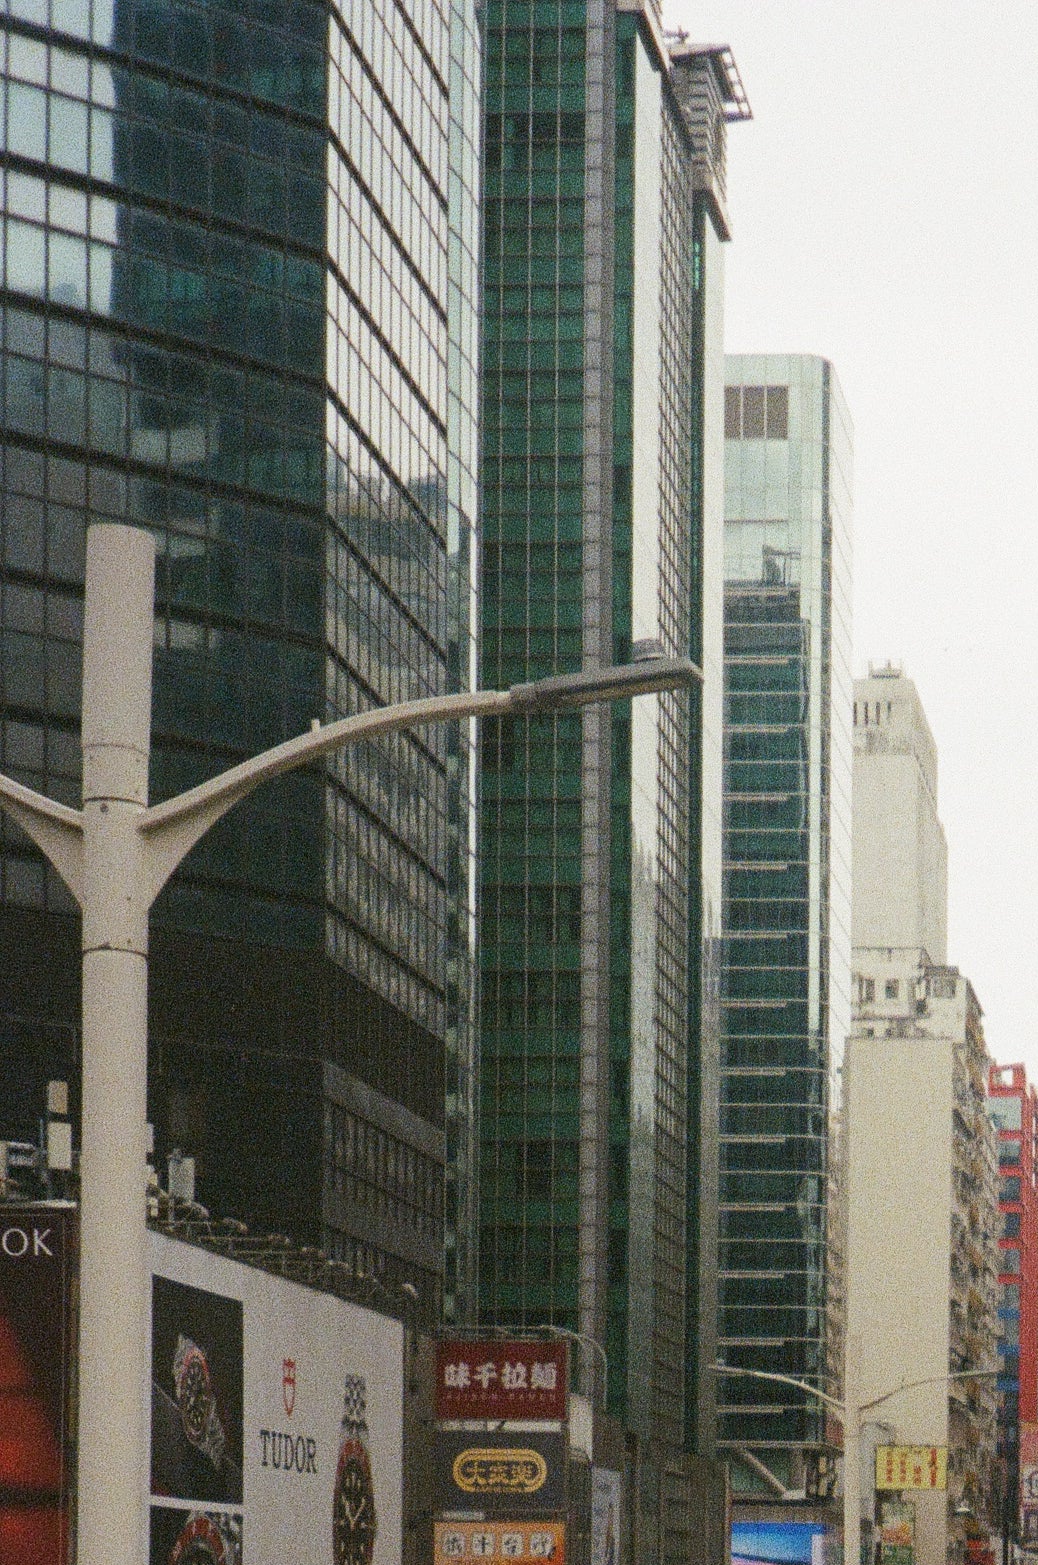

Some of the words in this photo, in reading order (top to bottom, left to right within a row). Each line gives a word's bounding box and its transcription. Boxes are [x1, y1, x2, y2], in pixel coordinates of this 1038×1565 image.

[444, 1362, 557, 1391] 味千拉麵
[259, 1430, 317, 1474] TUDOR
